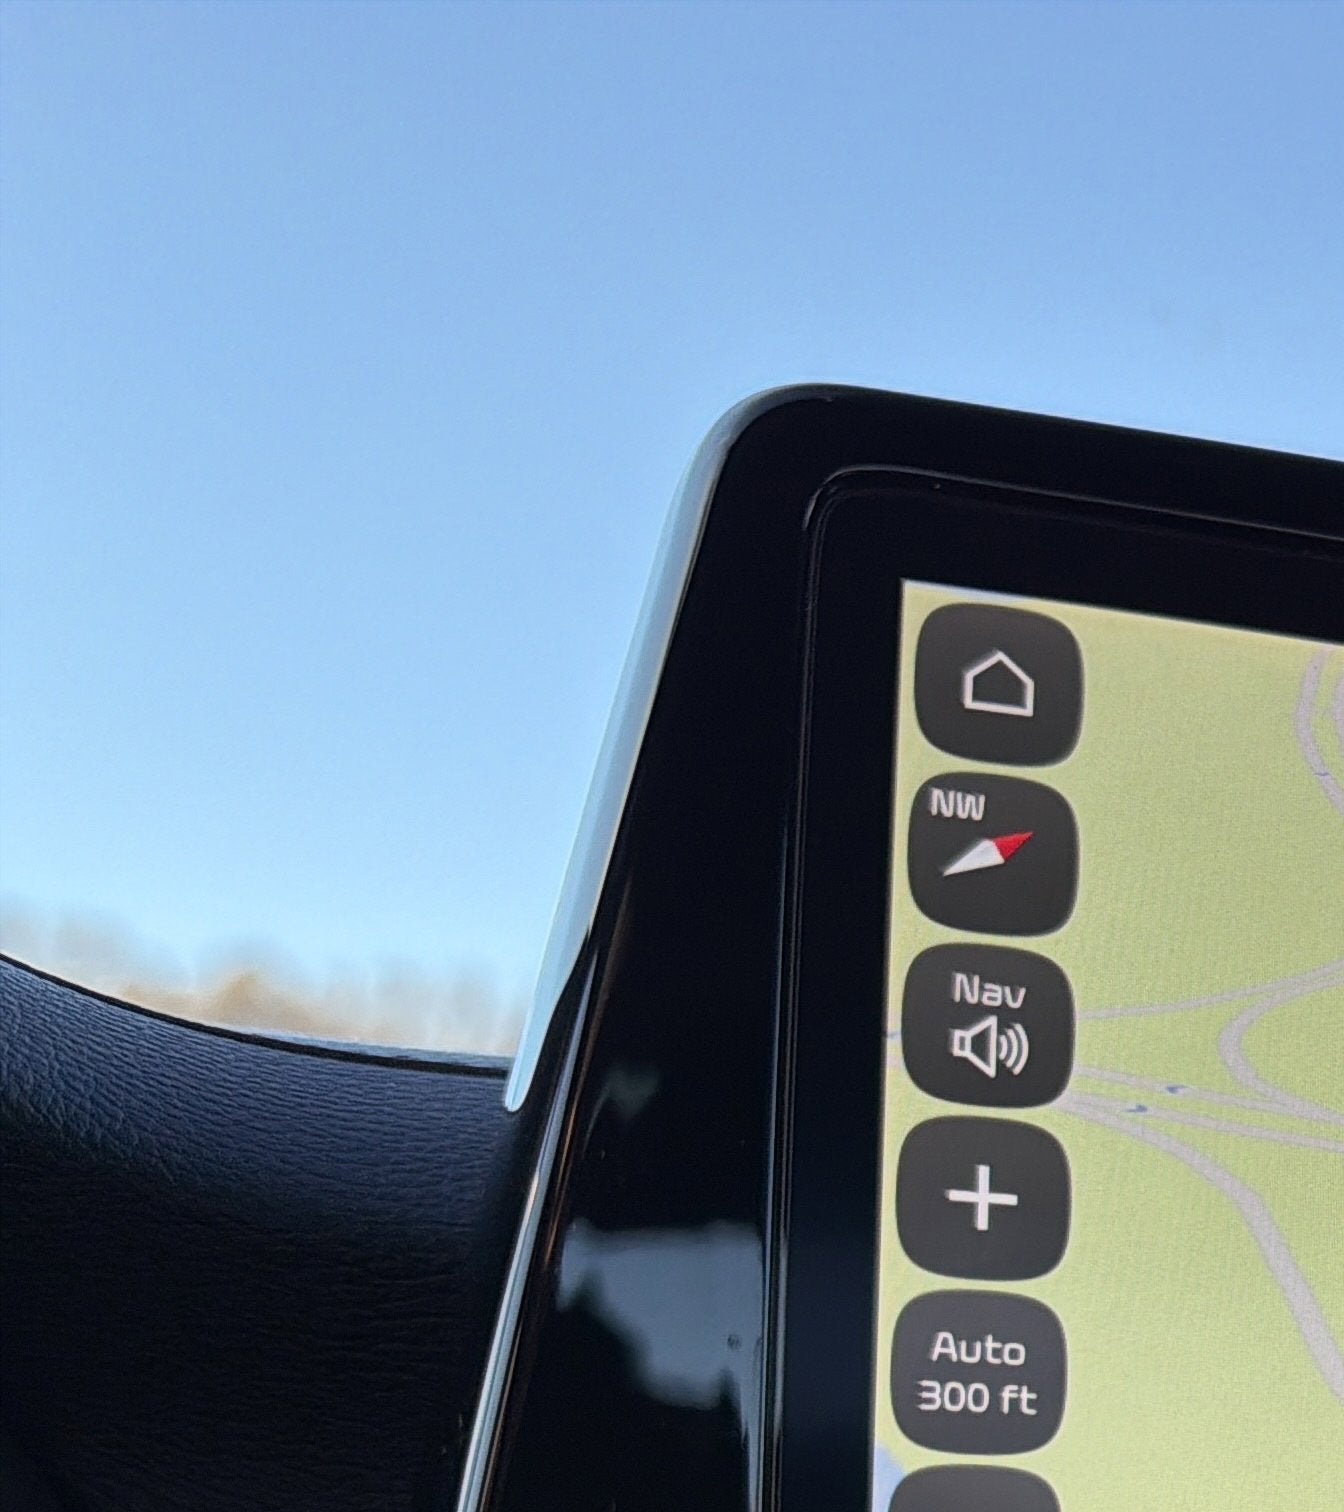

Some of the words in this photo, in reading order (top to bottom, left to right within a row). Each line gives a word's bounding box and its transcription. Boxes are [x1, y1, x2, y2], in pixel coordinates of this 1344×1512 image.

[930, 787, 986, 821] NW
[952, 972, 1026, 1008] Nav
[931, 1331, 1026, 1366] Auto
[917, 1380, 990, 1413] 300
[1001, 1385, 1038, 1415] ft
